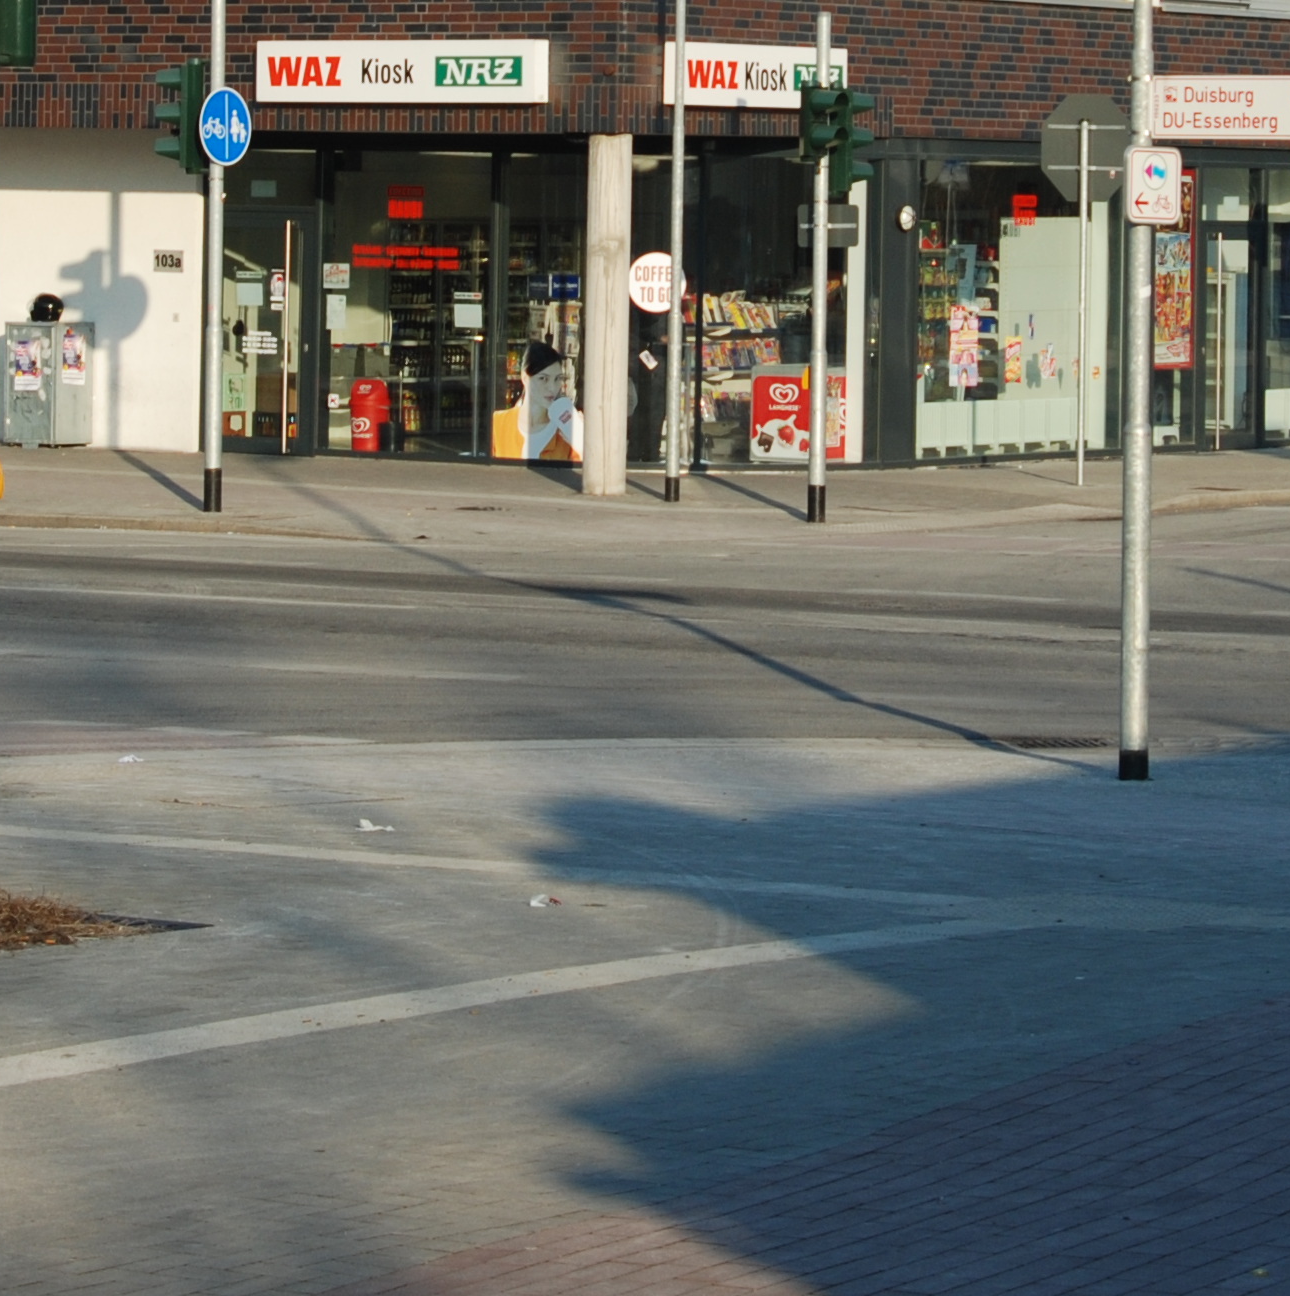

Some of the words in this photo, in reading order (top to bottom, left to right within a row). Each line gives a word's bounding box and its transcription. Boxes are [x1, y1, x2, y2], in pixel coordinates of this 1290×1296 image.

[267, 56, 342, 87] WAZ
[361, 58, 414, 84] Kiosk
[438, 58, 519, 85] NRZ
[687, 59, 739, 90] WAZ
[745, 61, 787, 91] Kiosk
[1184, 86, 1254, 107] Duisburg
[1163, 112, 1278, 133] DU-Essenberg
[155, 254, 182, 268] 103a
[634, 265, 672, 282] COFFE
[640, 287, 654, 302] TO
